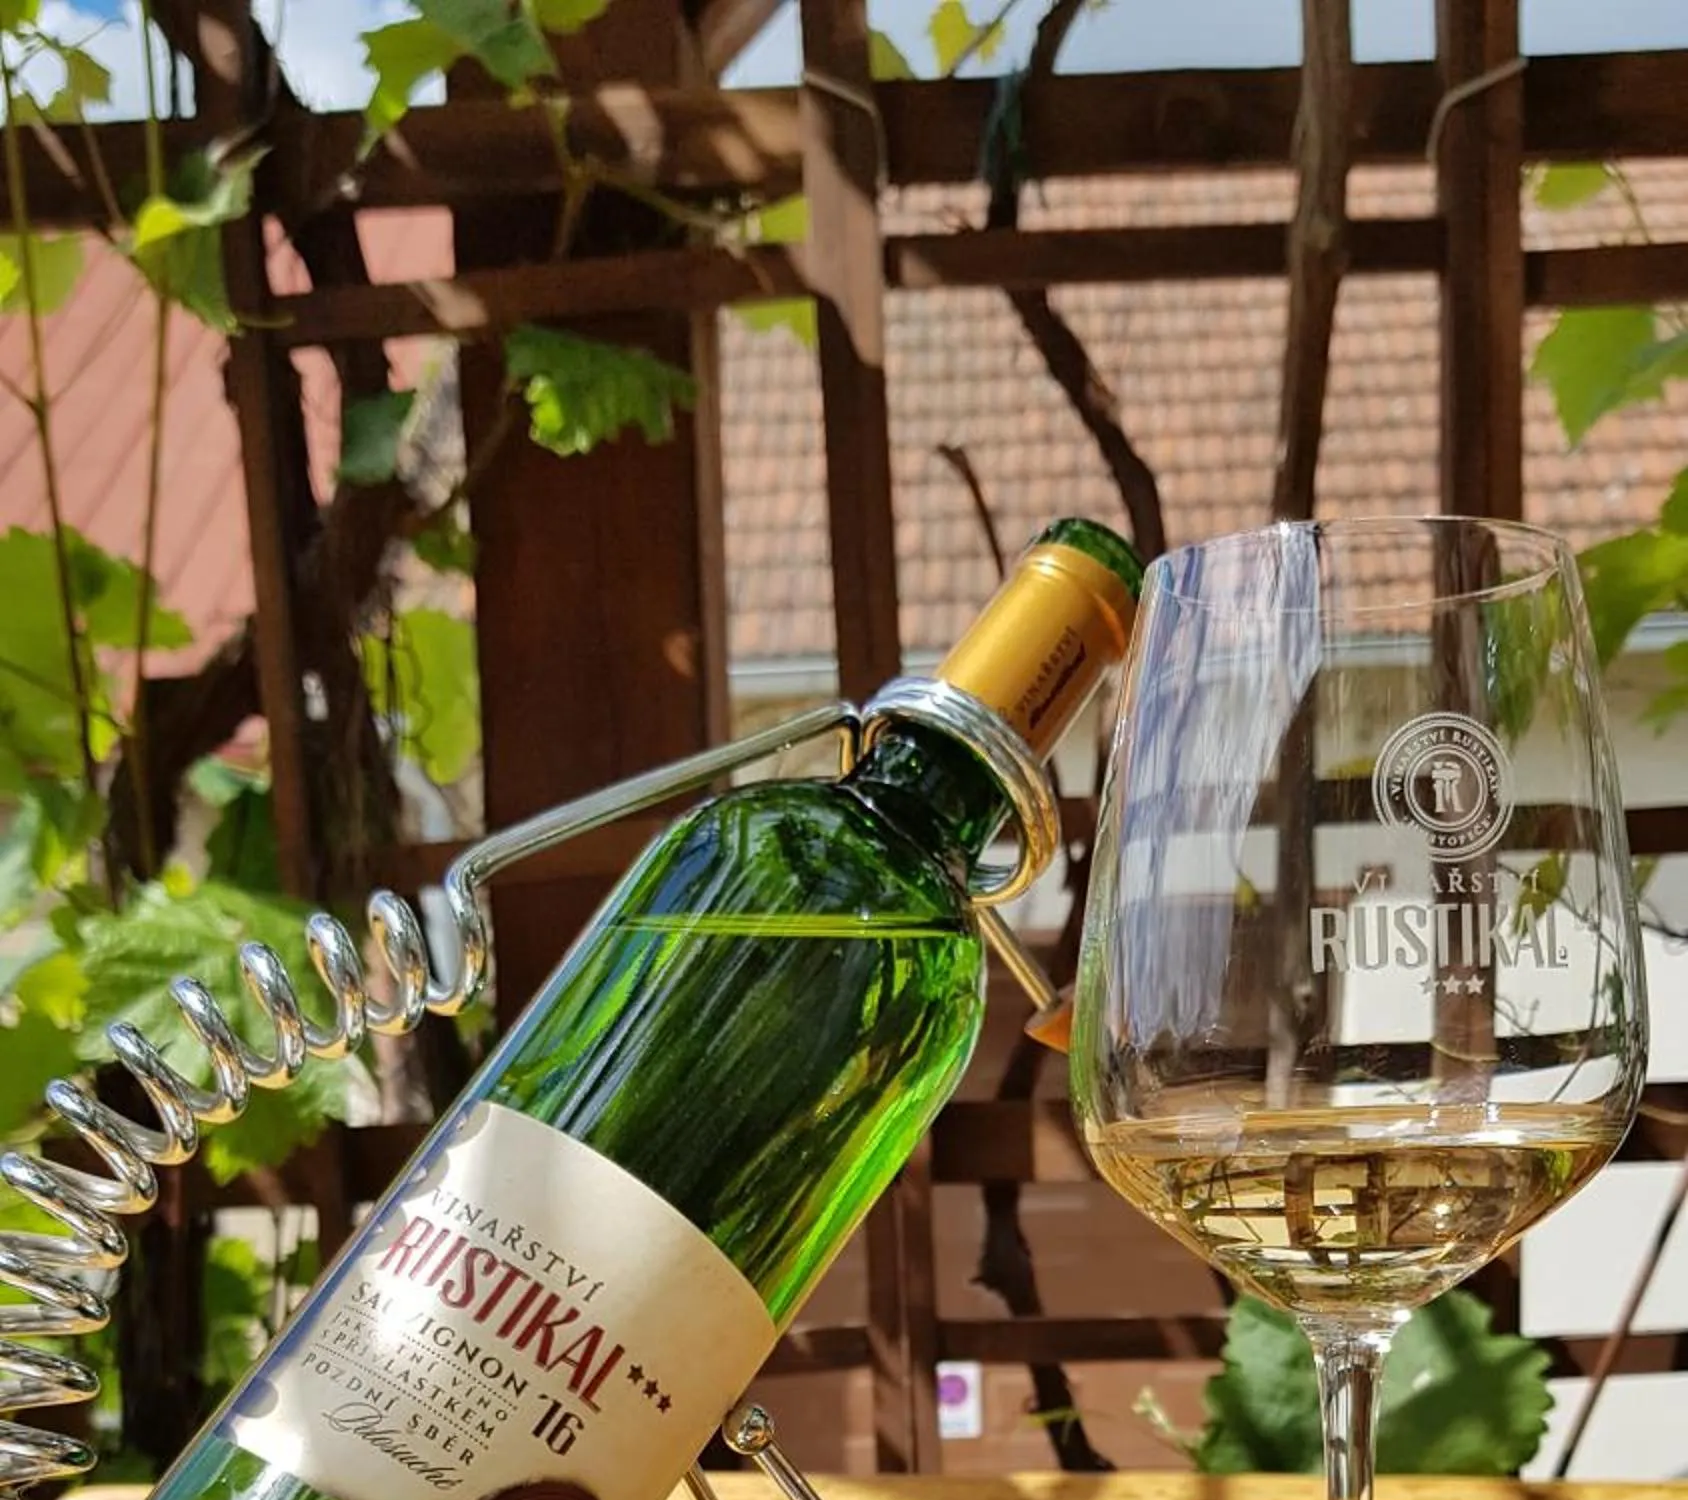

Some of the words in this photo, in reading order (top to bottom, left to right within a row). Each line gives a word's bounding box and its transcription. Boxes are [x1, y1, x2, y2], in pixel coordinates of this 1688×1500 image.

[1309, 902, 1570, 975] RUSTIKAL
[431, 1188, 605, 1302] VINAŘSTVÍ
[377, 1215, 626, 1414] RUSTIKAL
